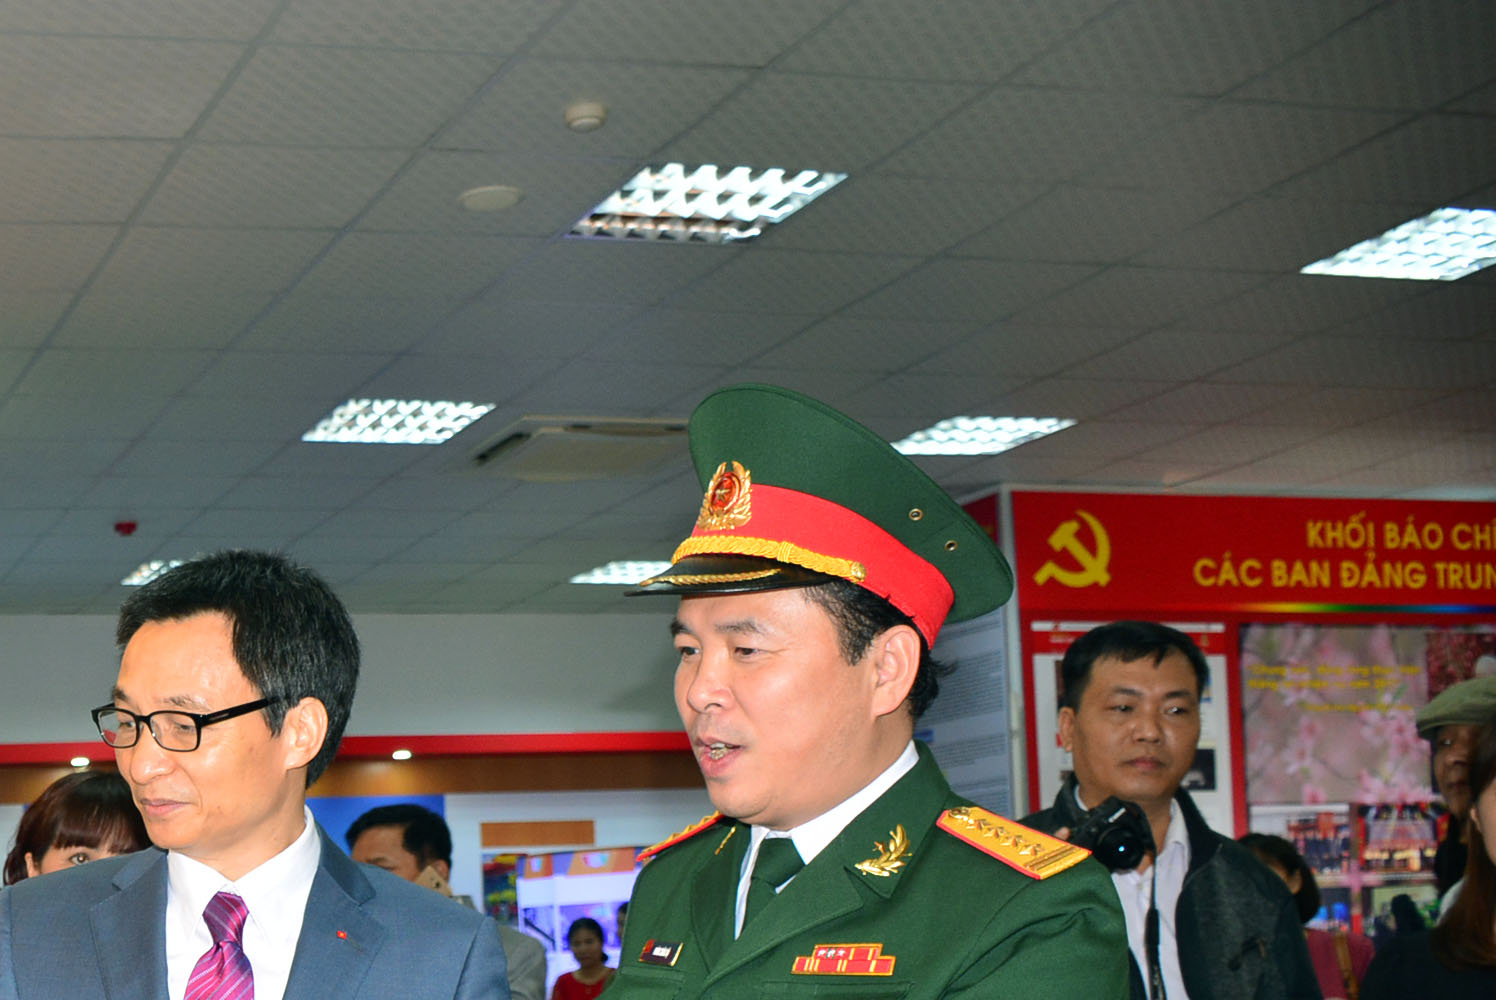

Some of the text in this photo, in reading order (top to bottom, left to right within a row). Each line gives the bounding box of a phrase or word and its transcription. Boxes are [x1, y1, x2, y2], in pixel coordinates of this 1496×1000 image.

[1307, 511, 1375, 548] KHỐI
[1384, 515, 1444, 550] BÁO
[1193, 550, 1263, 588] CÁC
[1271, 560, 1331, 588] BAN
[1340, 549, 1427, 589] ĐẢNG
